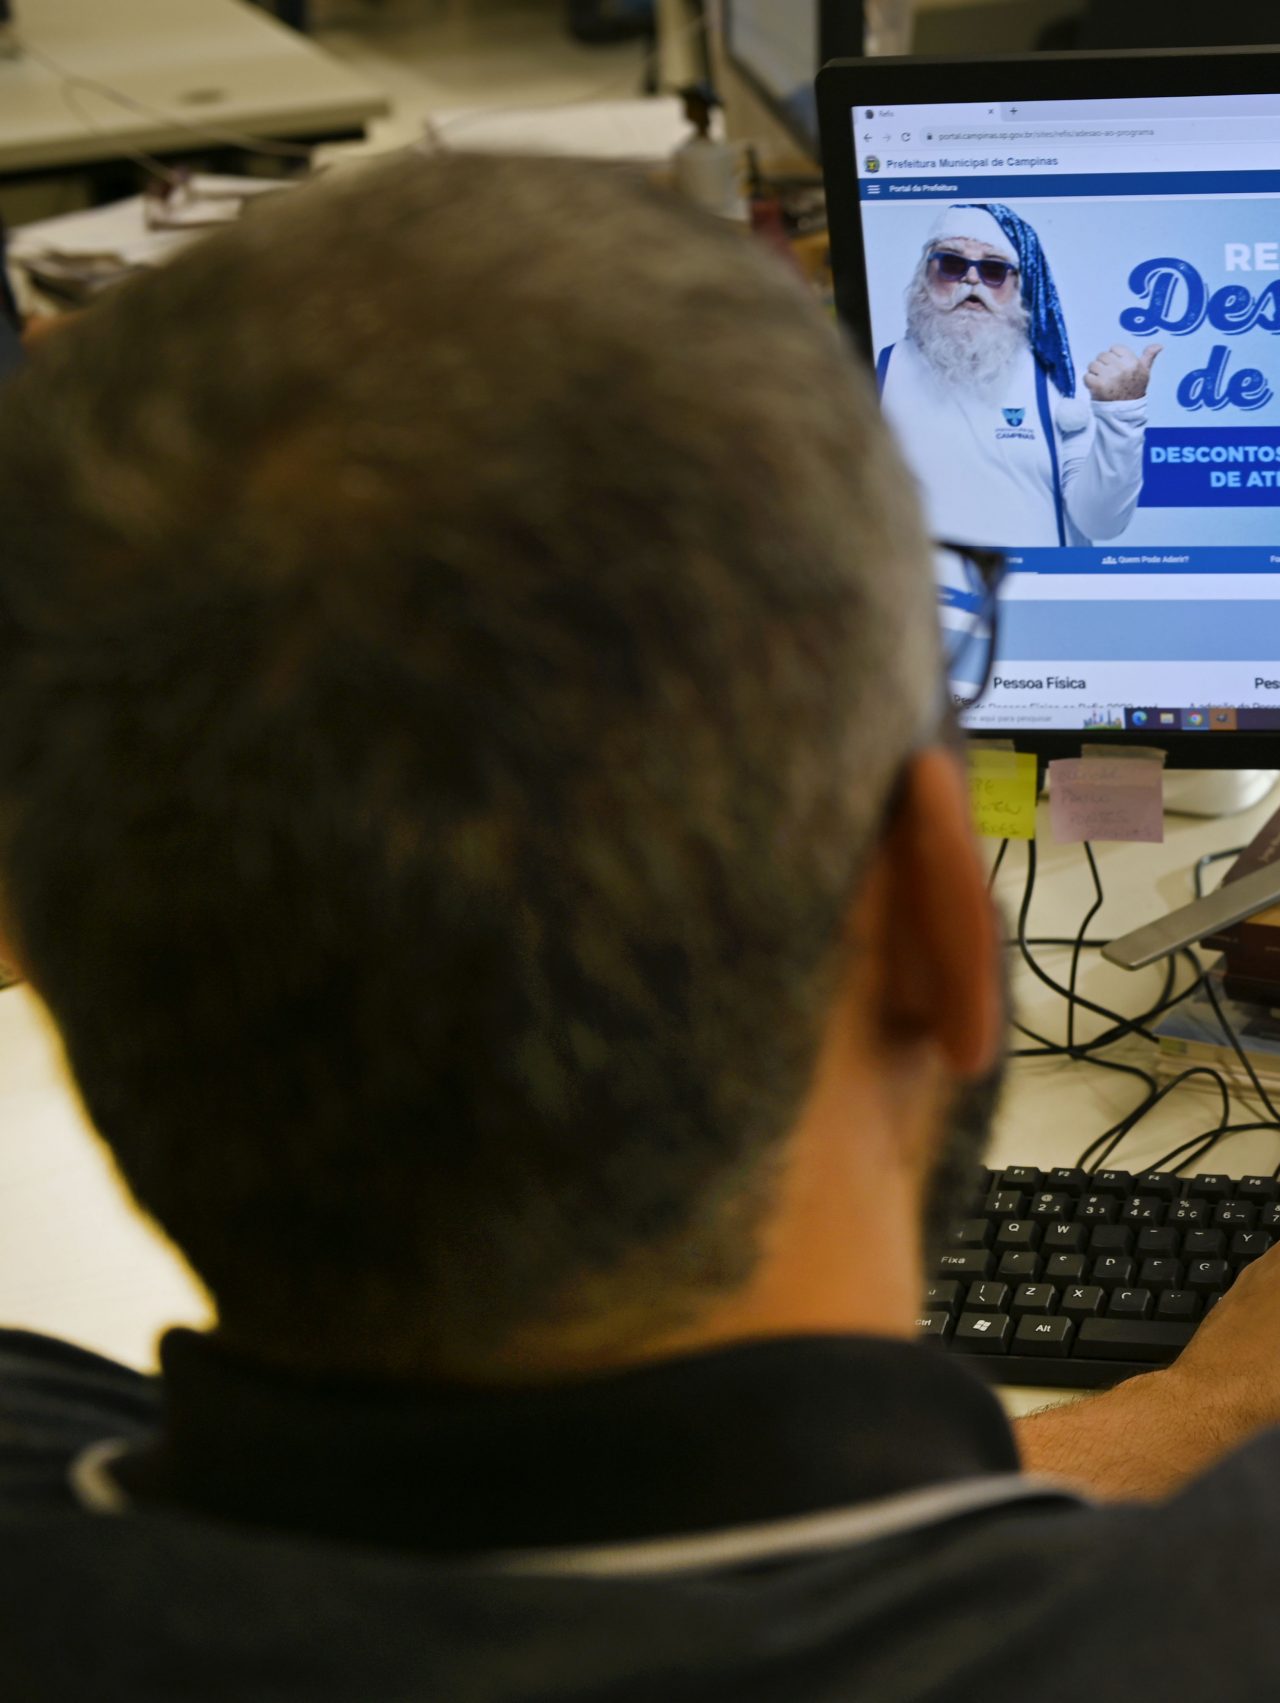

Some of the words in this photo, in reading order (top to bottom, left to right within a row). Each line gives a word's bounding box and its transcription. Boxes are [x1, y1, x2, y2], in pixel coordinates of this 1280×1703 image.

[886, 158, 937, 169] Prefeitura
[939, 157, 989, 169] Municipal
[991, 157, 1004, 168] de
[1006, 155, 1059, 169] Campinas
[889, 184, 911, 193] Portal
[922, 183, 958, 193] Prefeitura
[1176, 344, 1274, 412] de
[1210, 471, 1242, 488] DE
[1118, 556, 1140, 565] Quem
[1142, 555, 1161, 564] Pode
[993, 677, 1043, 689] Pessoa
[1047, 676, 1087, 689] Física
[1204, 1176, 1217, 1184] F5
[1008, 1223, 1020, 1232] Q
[1057, 1225, 1070, 1234] W
[1242, 1233, 1253, 1242] Y
[940, 1256, 967, 1265] Fixa
[1025, 1287, 1036, 1296] Z
[1072, 1289, 1084, 1298] X
[1035, 1324, 1051, 1333] Alt
